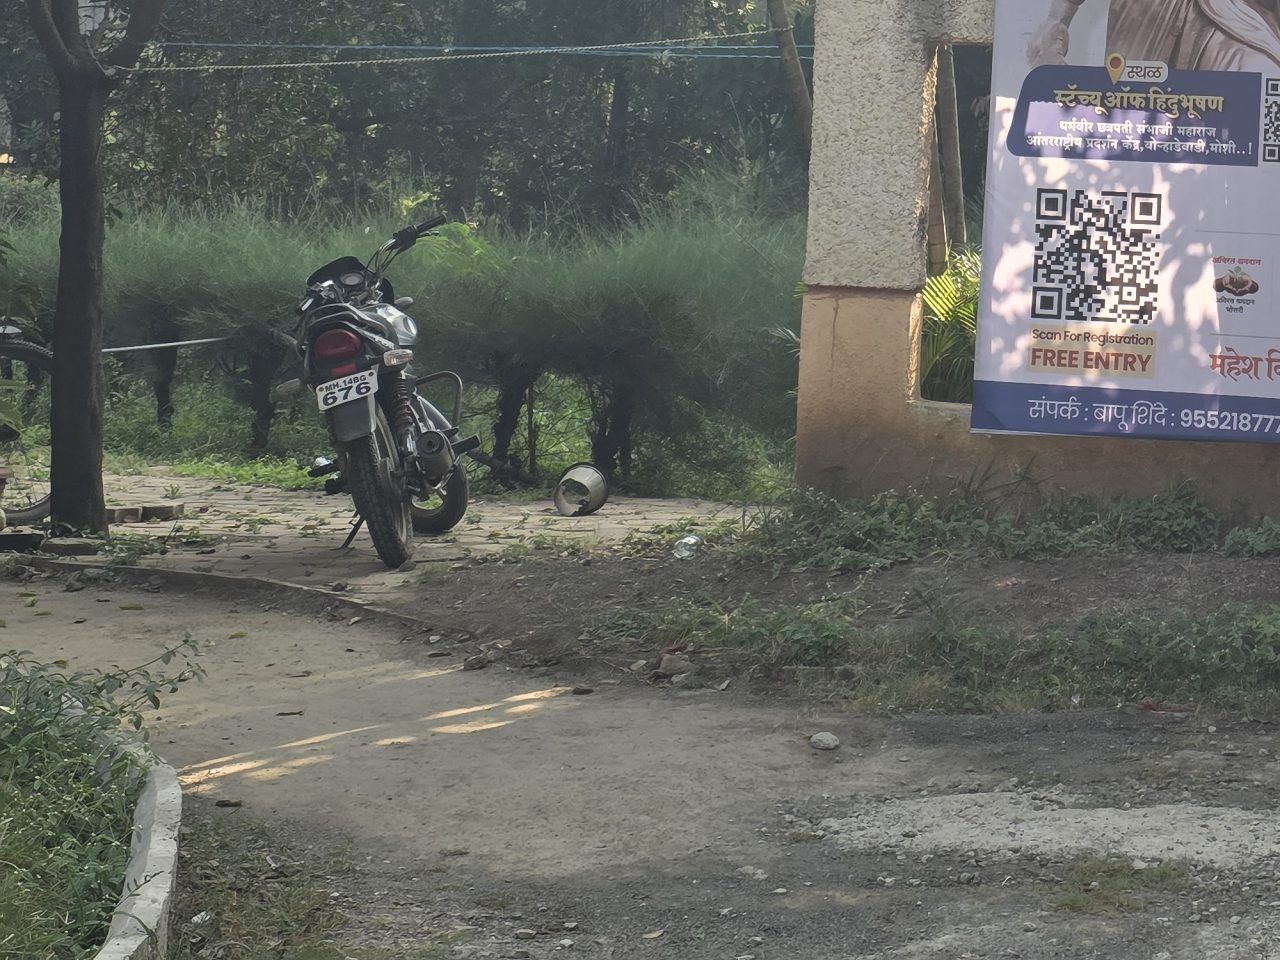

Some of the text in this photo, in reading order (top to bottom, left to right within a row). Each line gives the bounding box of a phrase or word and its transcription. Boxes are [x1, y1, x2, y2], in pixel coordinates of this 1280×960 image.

[1126, 65, 1164, 80] स्थळ
[1105, 85, 1151, 110] ऑफ
[1148, 86, 1225, 120] हिंदुभूषण
[1059, 117, 1094, 134] धर्मवीर
[1177, 125, 1217, 139] महाराज
[1031, 328, 1154, 347] Scan For Registration
[1030, 347, 1152, 372] FREE ENTRY
[1209, 346, 1263, 382] महेश
[322, 381, 372, 407] 676
[1027, 395, 1082, 421] संपर्क
[1092, 402, 1129, 431] बापू
[1130, 400, 1169, 427] शिंदे
